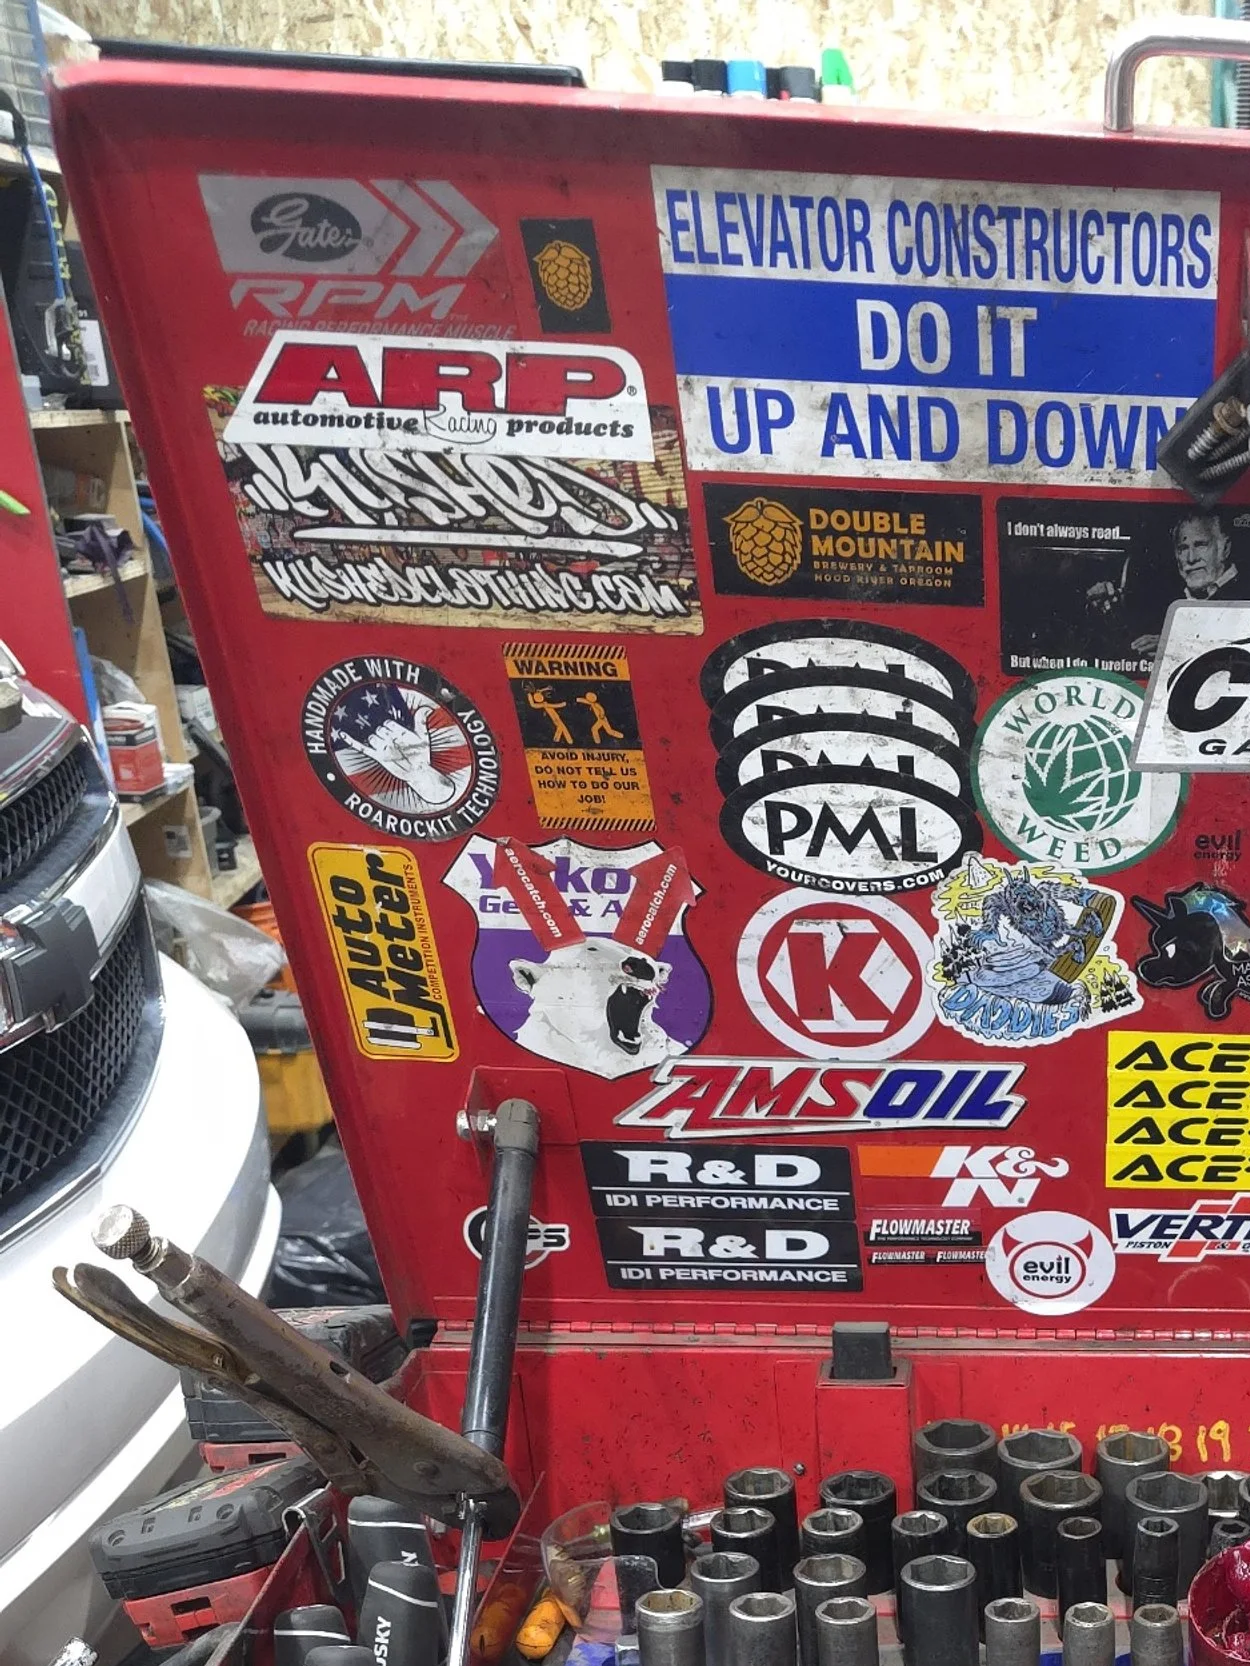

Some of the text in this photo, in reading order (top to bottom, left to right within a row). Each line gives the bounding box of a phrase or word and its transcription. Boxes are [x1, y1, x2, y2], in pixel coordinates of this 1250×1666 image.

[665, 188, 1213, 289] ELEVATOR CONSTRUCTORS
[229, 280, 466, 320] RPM
[856, 298, 1038, 378] DO IT
[252, 342, 628, 417] ARP
[252, 407, 420, 431] automotive
[505, 415, 635, 440] products
[707, 385, 1189, 472] UP AND DOWN
[809, 507, 927, 536] DOUBLE
[1007, 521, 1090, 540] I don't always
[811, 534, 965, 563] MOUNTAIN
[813, 561, 954, 575] BREWERY & TAPROOM
[814, 573, 953, 588] HOOD RIVER OREGON
[514, 659, 619, 678] WARNING
[1010, 655, 1031, 669] But
[1033, 657, 1064, 669] when
[304, 658, 421, 755] HANDMADE WITH
[1003, 685, 1136, 735] WORLD
[456, 708, 498, 824] TECHNOLOGY
[535, 765, 638, 777] DO NOT TELL US
[541, 751, 630, 764] AVOID INJURY,
[537, 780, 641, 791] HOW TO DO OUR
[577, 794, 606, 805] JOB!
[344, 792, 458, 839] ROAROCKIT
[764, 800, 939, 863] PML
[1016, 813, 1122, 863] WEED
[1194, 829, 1241, 851] evil
[1193, 850, 1243, 863] energy
[766, 859, 946, 893] YOURCOVERS.COM
[504, 847, 563, 939] aerocatch.com
[635, 862, 678, 946] aerocatch.com
[329, 874, 392, 1001] Auto
[366, 851, 434, 1009] Meter
[402, 863, 444, 1002] COMPETITION INSTRUMENTS
[640, 1067, 1020, 1124] AMSOIL
[613, 1150, 823, 1188] R&D
[605, 1193, 841, 1212] IDI PERFORMANCE
[627, 1225, 831, 1261] R&D
[869, 1218, 972, 1242] FLOWMASTER
[1124, 1241, 1173, 1249] PISTON
[871, 1250, 989, 1264] FLOWMASTER FLOWMASTE
[1022, 1256, 1071, 1275] evil
[620, 1267, 848, 1283] IDI PERFORMANCE
[1022, 1274, 1072, 1285] energy
[1198, 1420, 1231, 1463] 19
